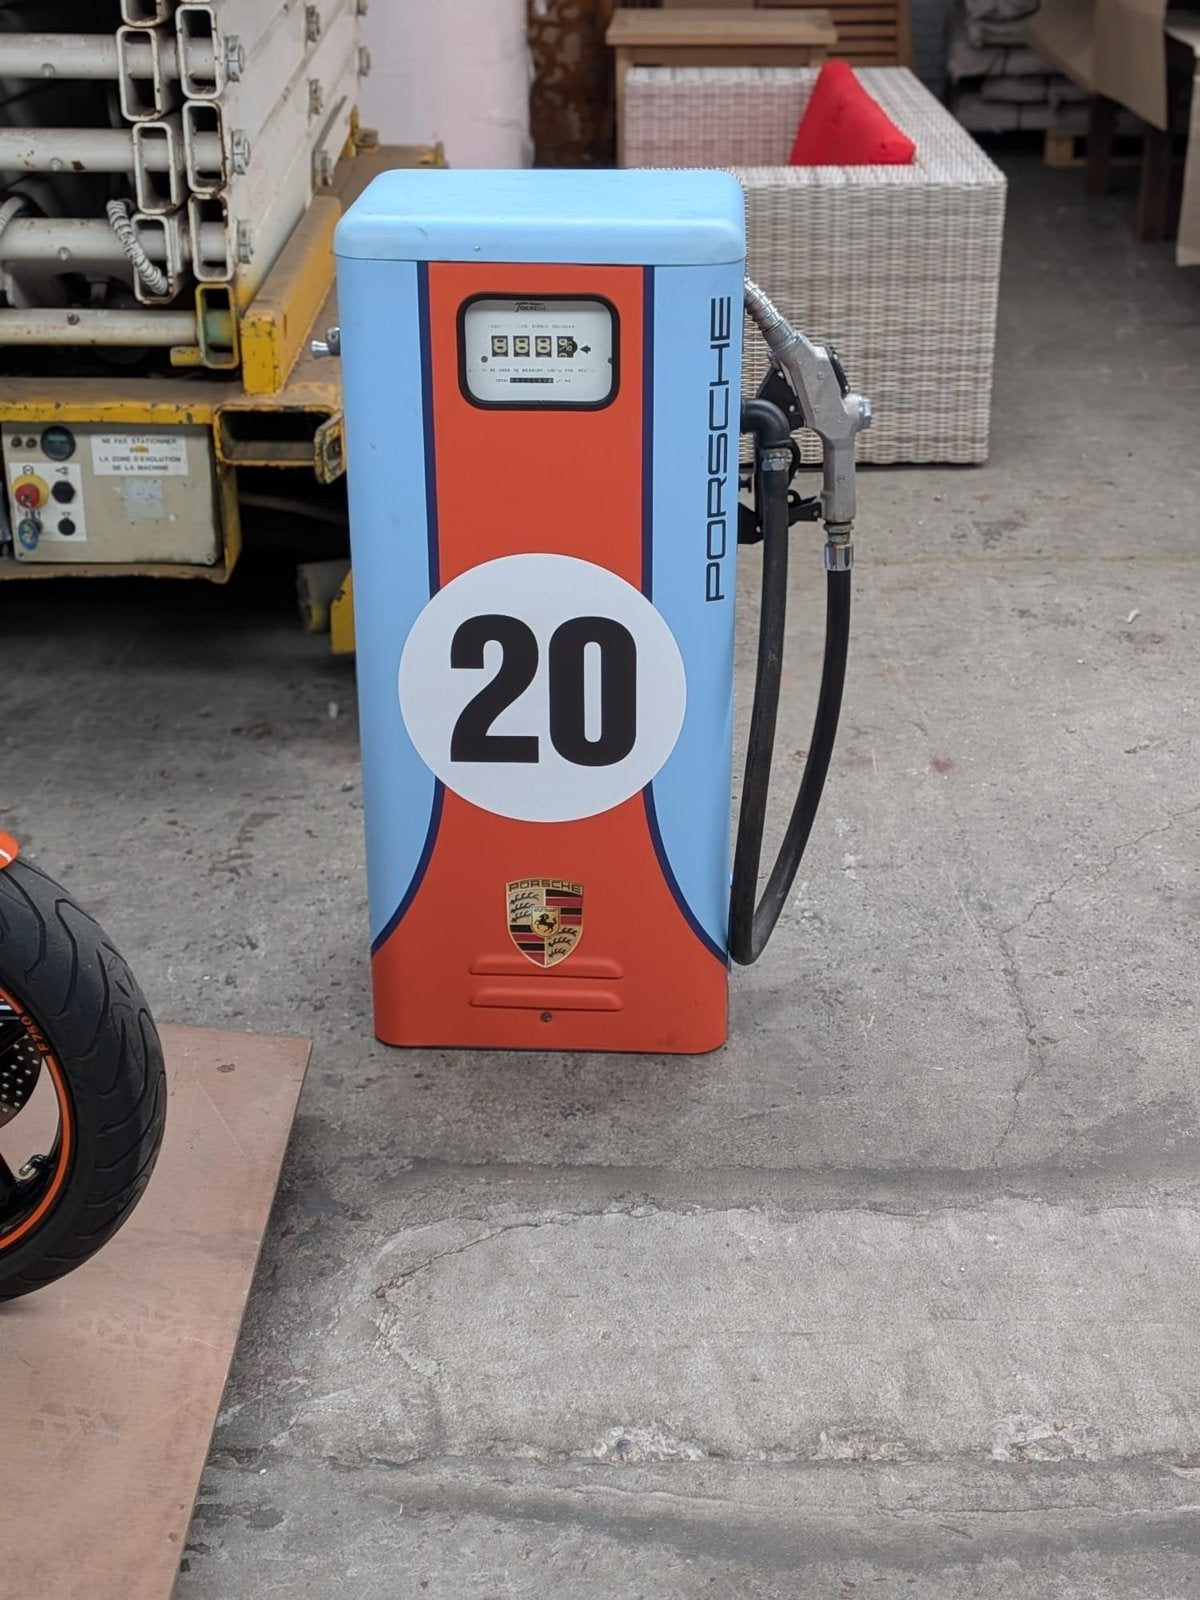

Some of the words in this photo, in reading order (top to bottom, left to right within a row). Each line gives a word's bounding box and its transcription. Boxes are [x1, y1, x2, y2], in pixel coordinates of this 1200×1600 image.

[706, 296, 732, 602] PORSCHE
[450, 613, 637, 768] 20
[509, 880, 582, 893] PORSCHE
